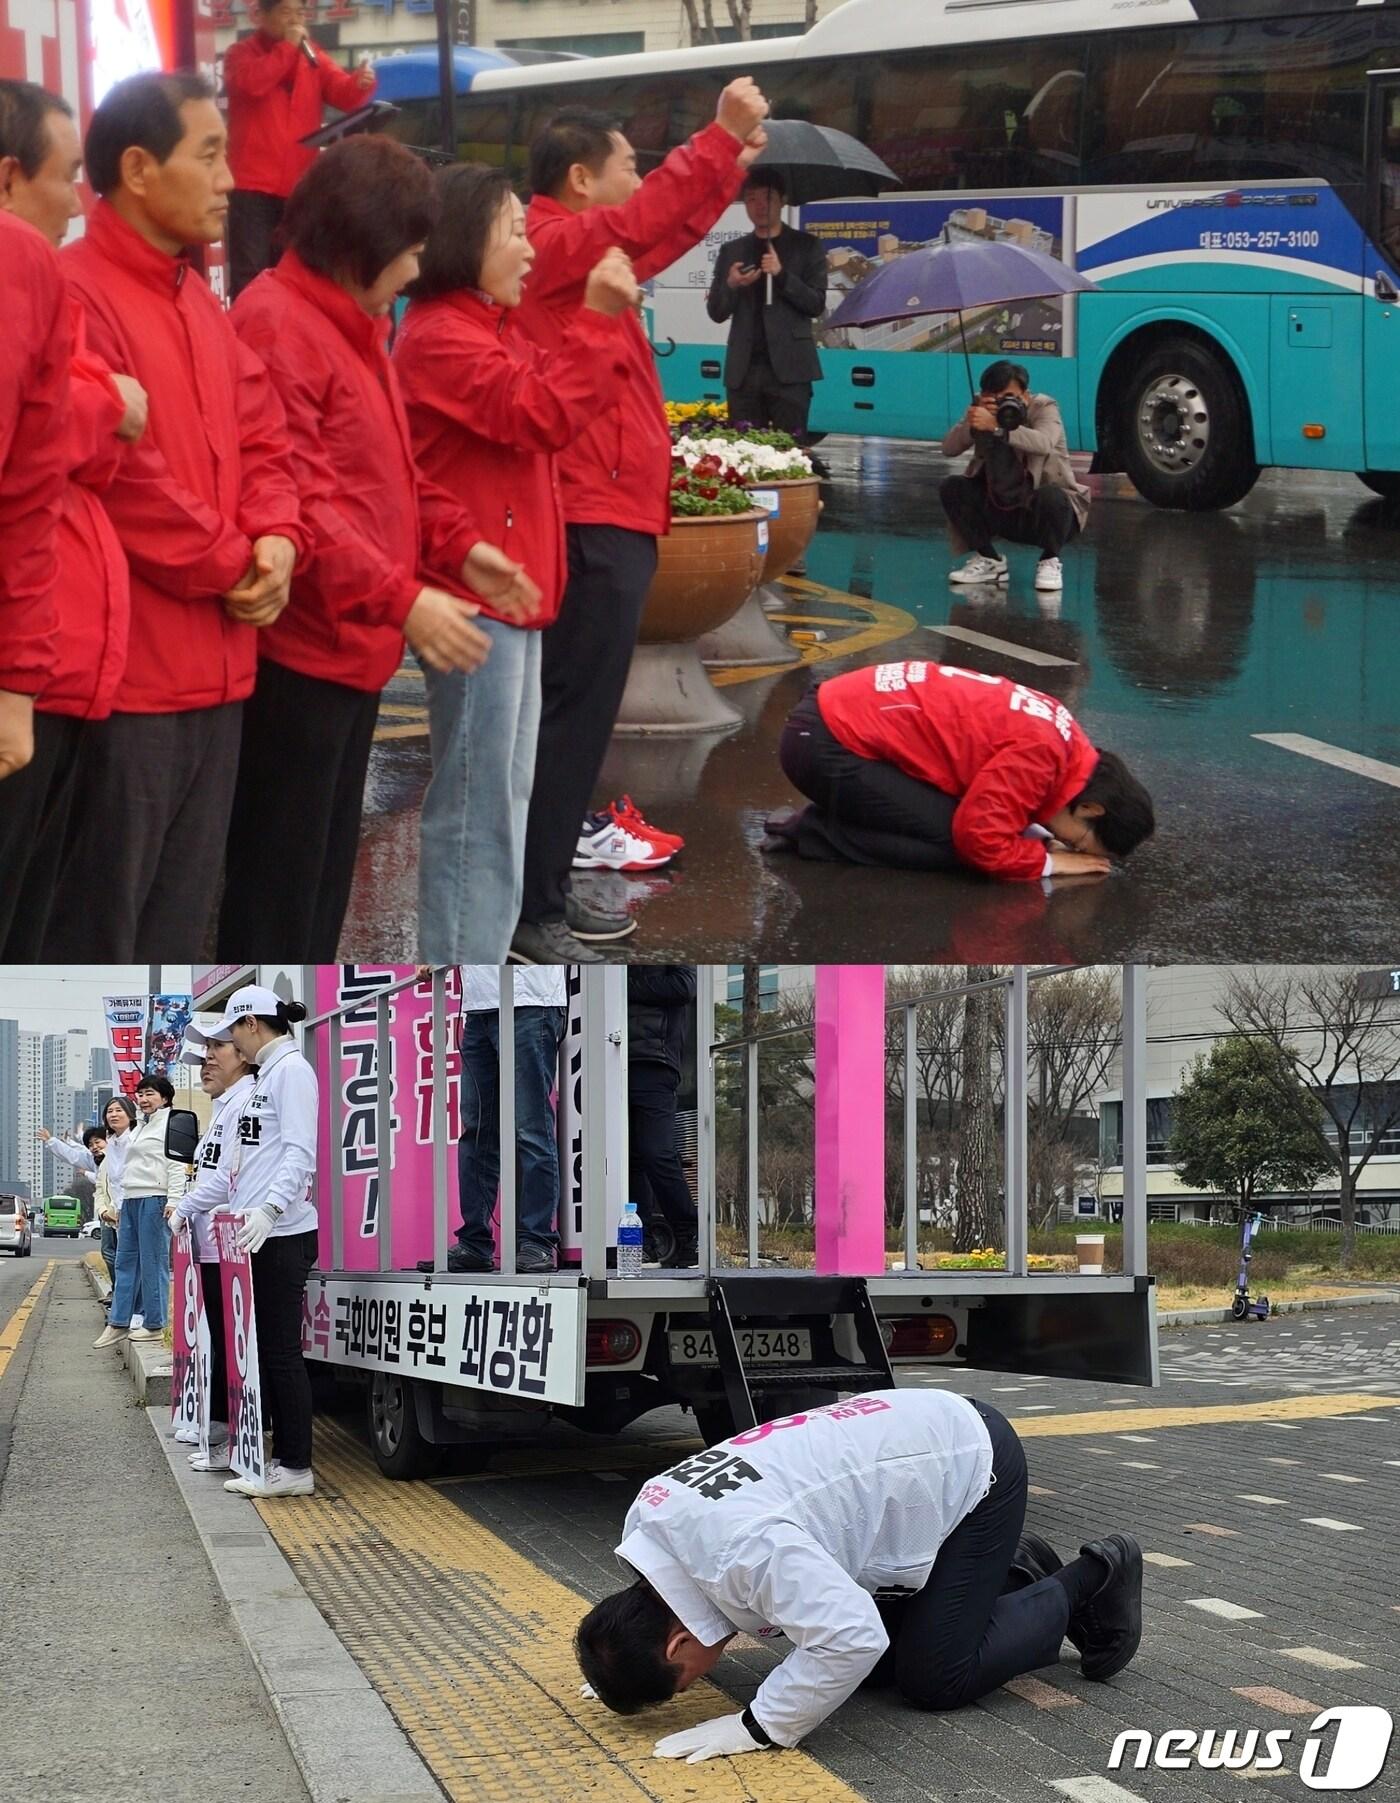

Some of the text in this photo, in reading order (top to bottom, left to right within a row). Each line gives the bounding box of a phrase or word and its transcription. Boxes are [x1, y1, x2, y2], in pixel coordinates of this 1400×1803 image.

[1199, 231, 1319, 250] 대표:053-257-3100
[109, 999, 142, 1008] 가족뮤지컬
[238, 1115, 262, 1146] 환
[201, 1141, 221, 1170] 환
[232, 1274, 249, 1381] 8
[335, 1295, 401, 1364] 국회의원
[407, 1299, 447, 1367] 후보
[459, 1295, 553, 1395] 최경환
[682, 1333, 801, 1359] 84 2348
